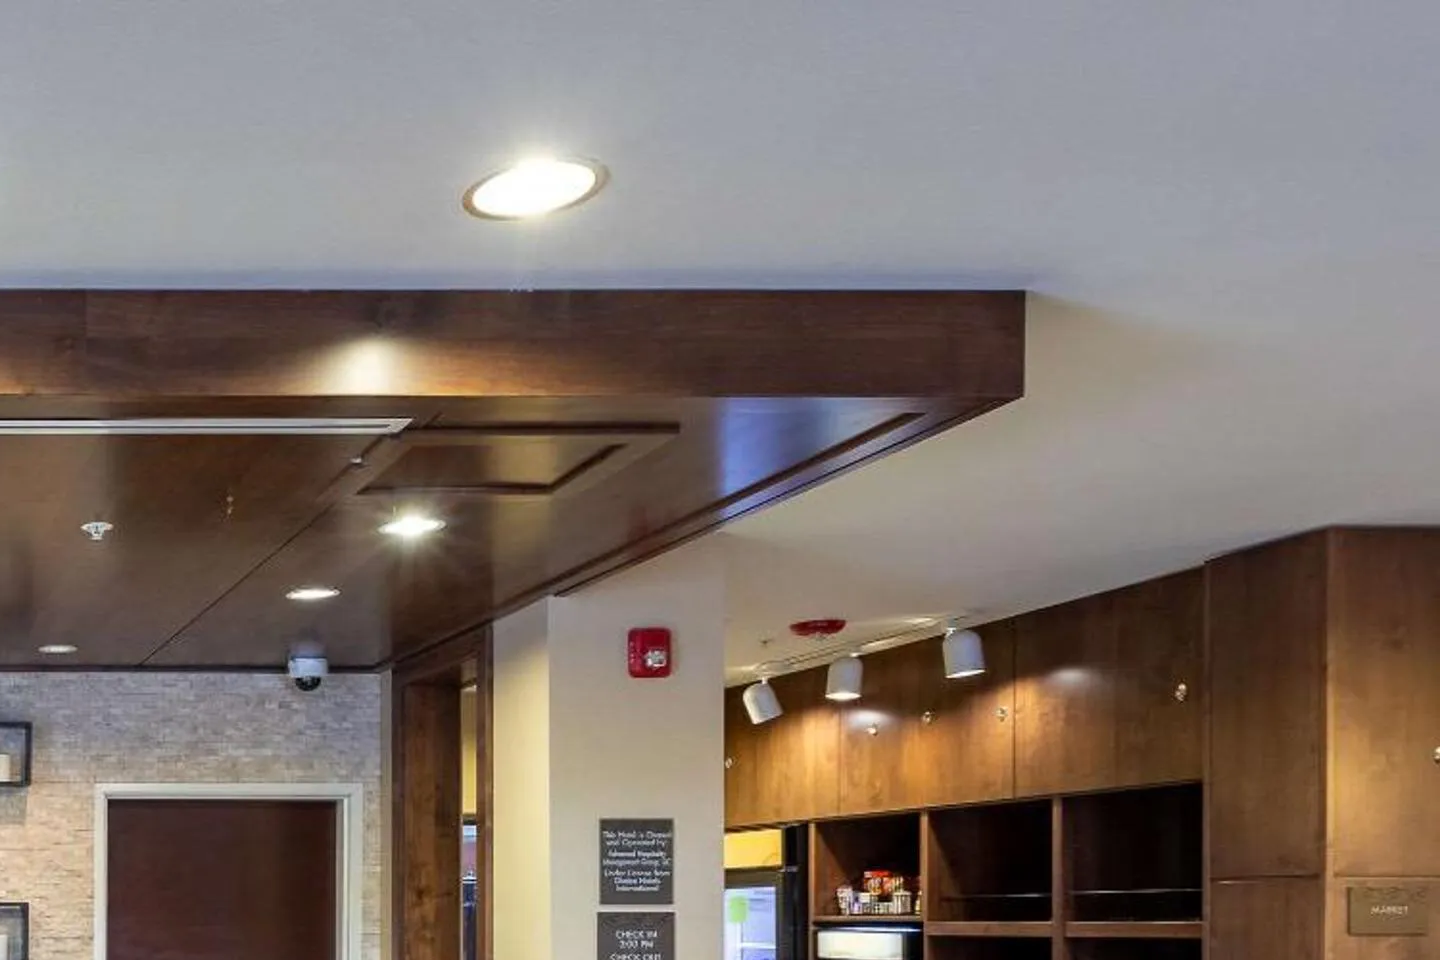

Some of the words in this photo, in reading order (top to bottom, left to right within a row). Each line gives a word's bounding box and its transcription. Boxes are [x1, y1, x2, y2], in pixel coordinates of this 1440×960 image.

[615, 930, 644, 939] CHECK
[646, 930, 658, 938] IN
[640, 940, 654, 949] PM
